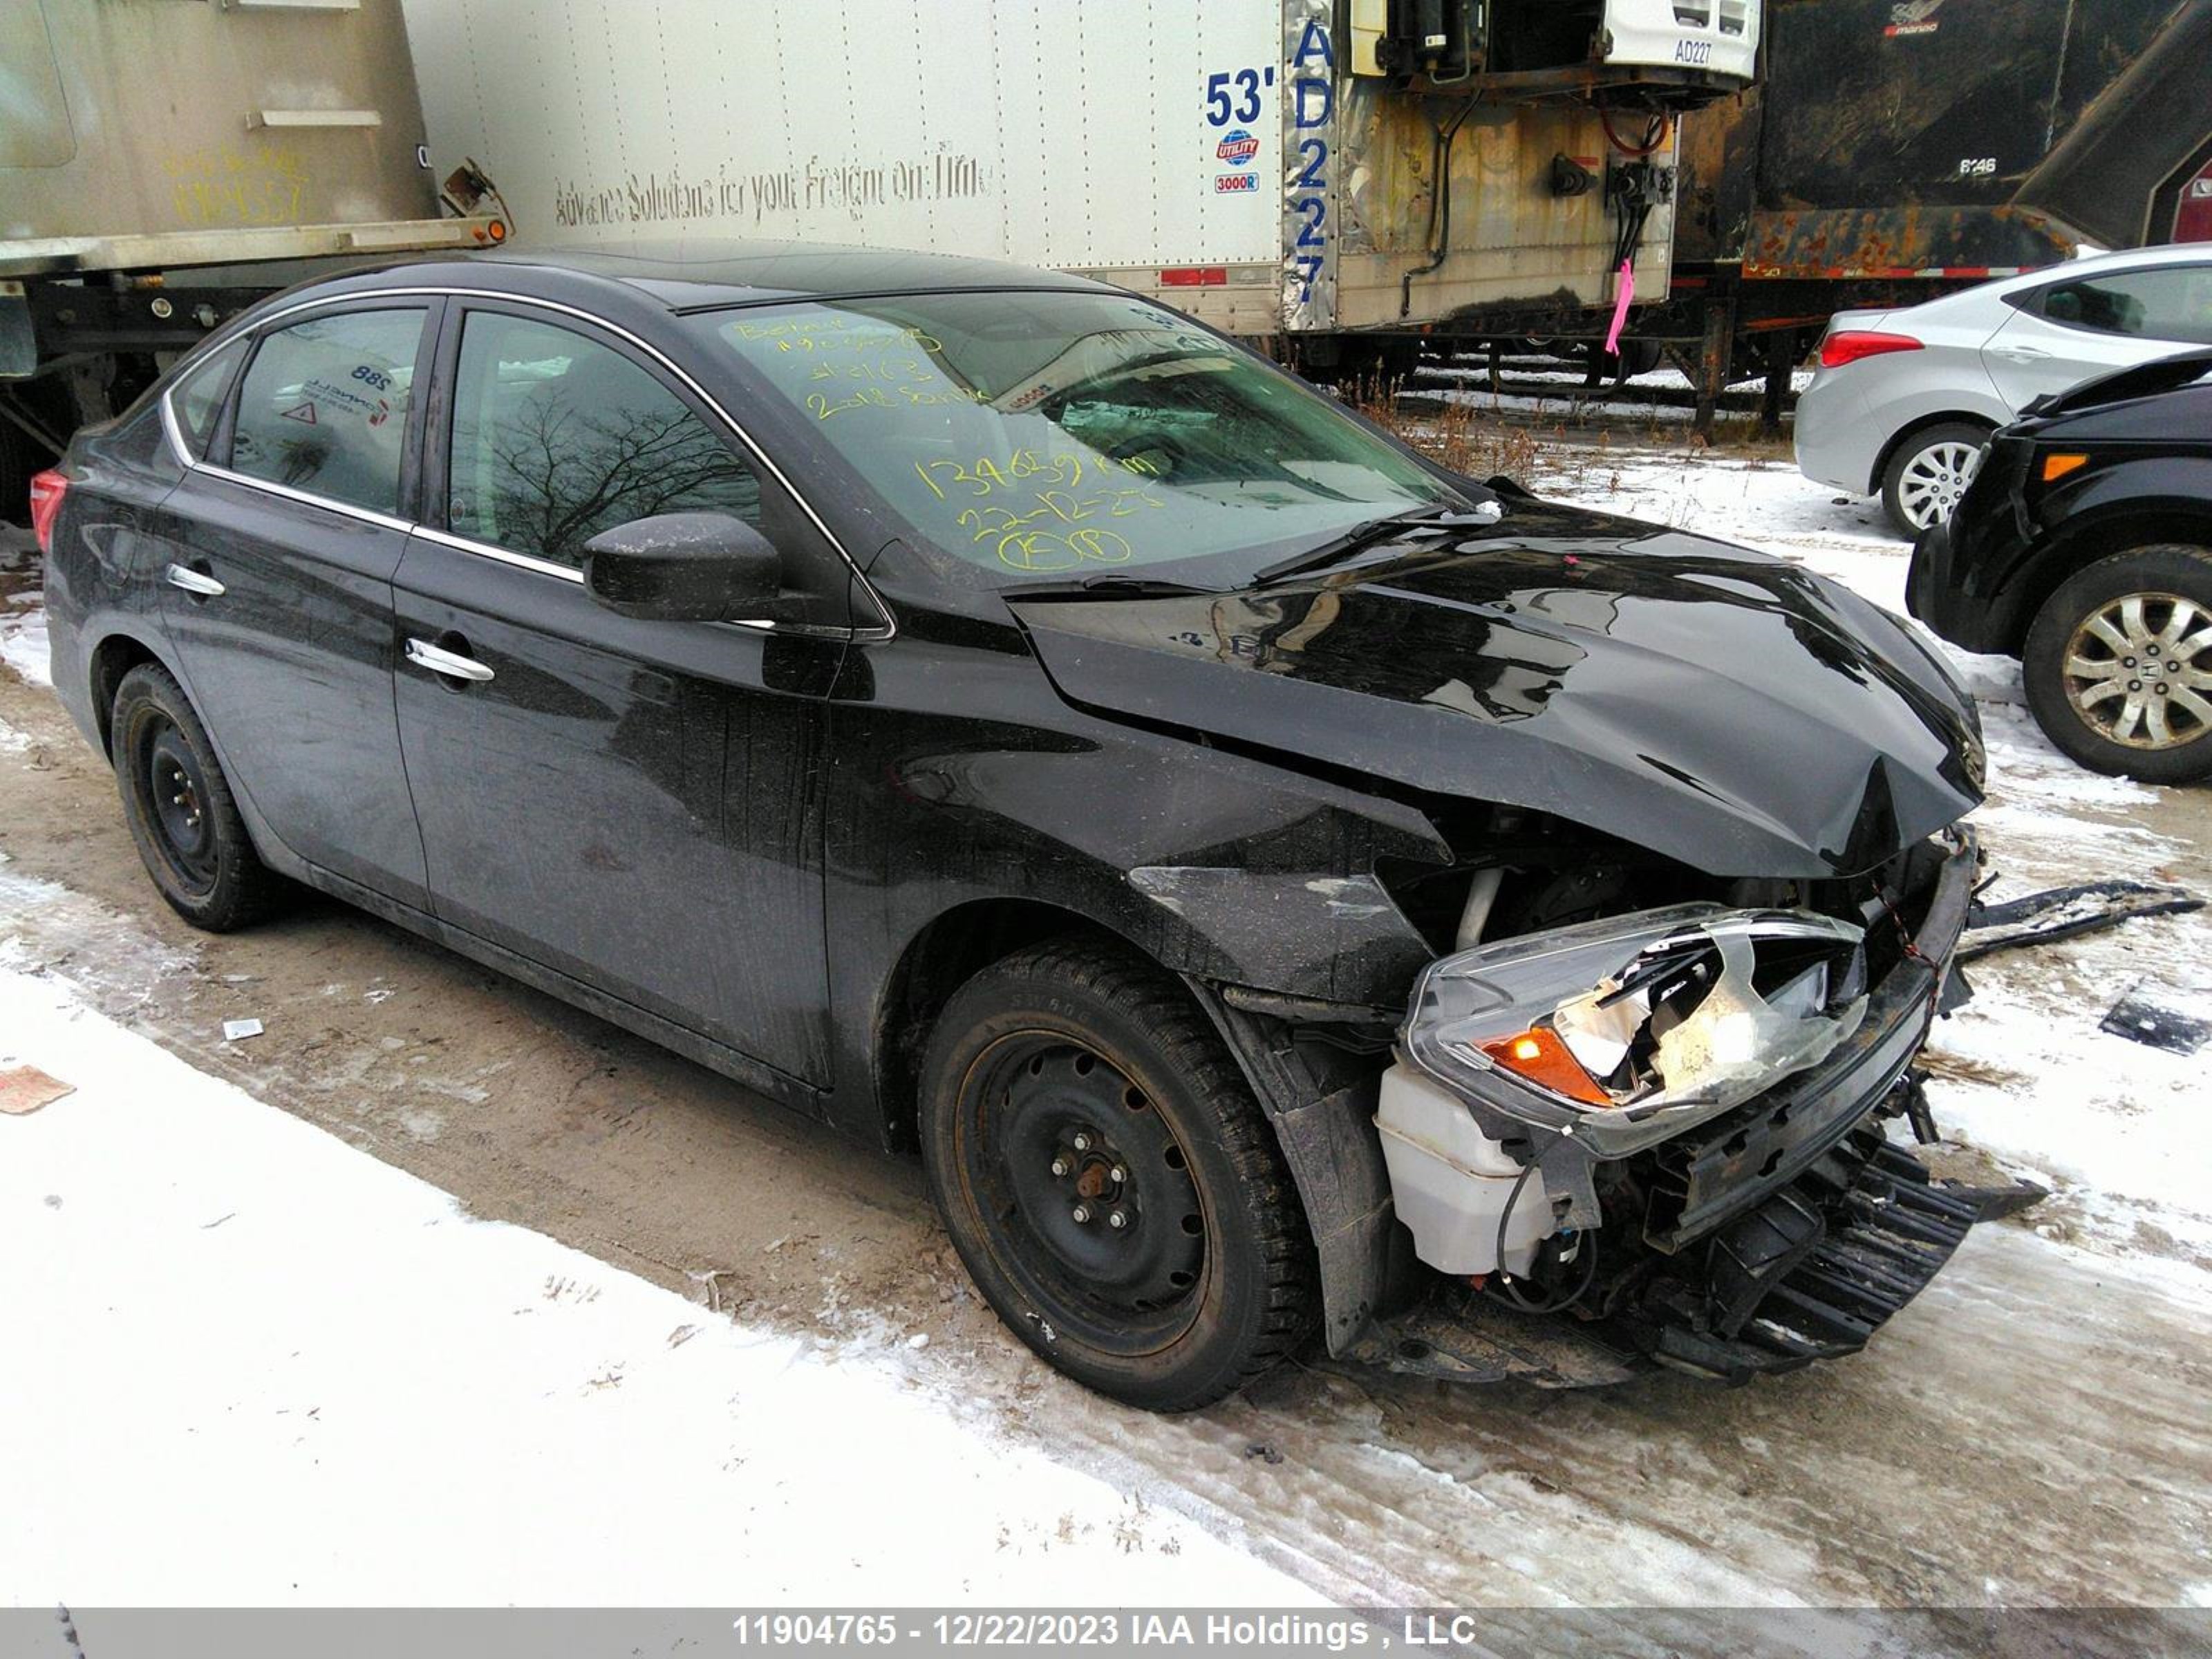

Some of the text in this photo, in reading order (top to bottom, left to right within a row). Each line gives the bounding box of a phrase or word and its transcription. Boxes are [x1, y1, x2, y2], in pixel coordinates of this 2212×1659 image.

[1675, 39, 1712, 64] AD227
[1206, 66, 1275, 126] 53'
[1217, 140, 1258, 158] UTILITY
[1217, 176, 1255, 190] 3000R
